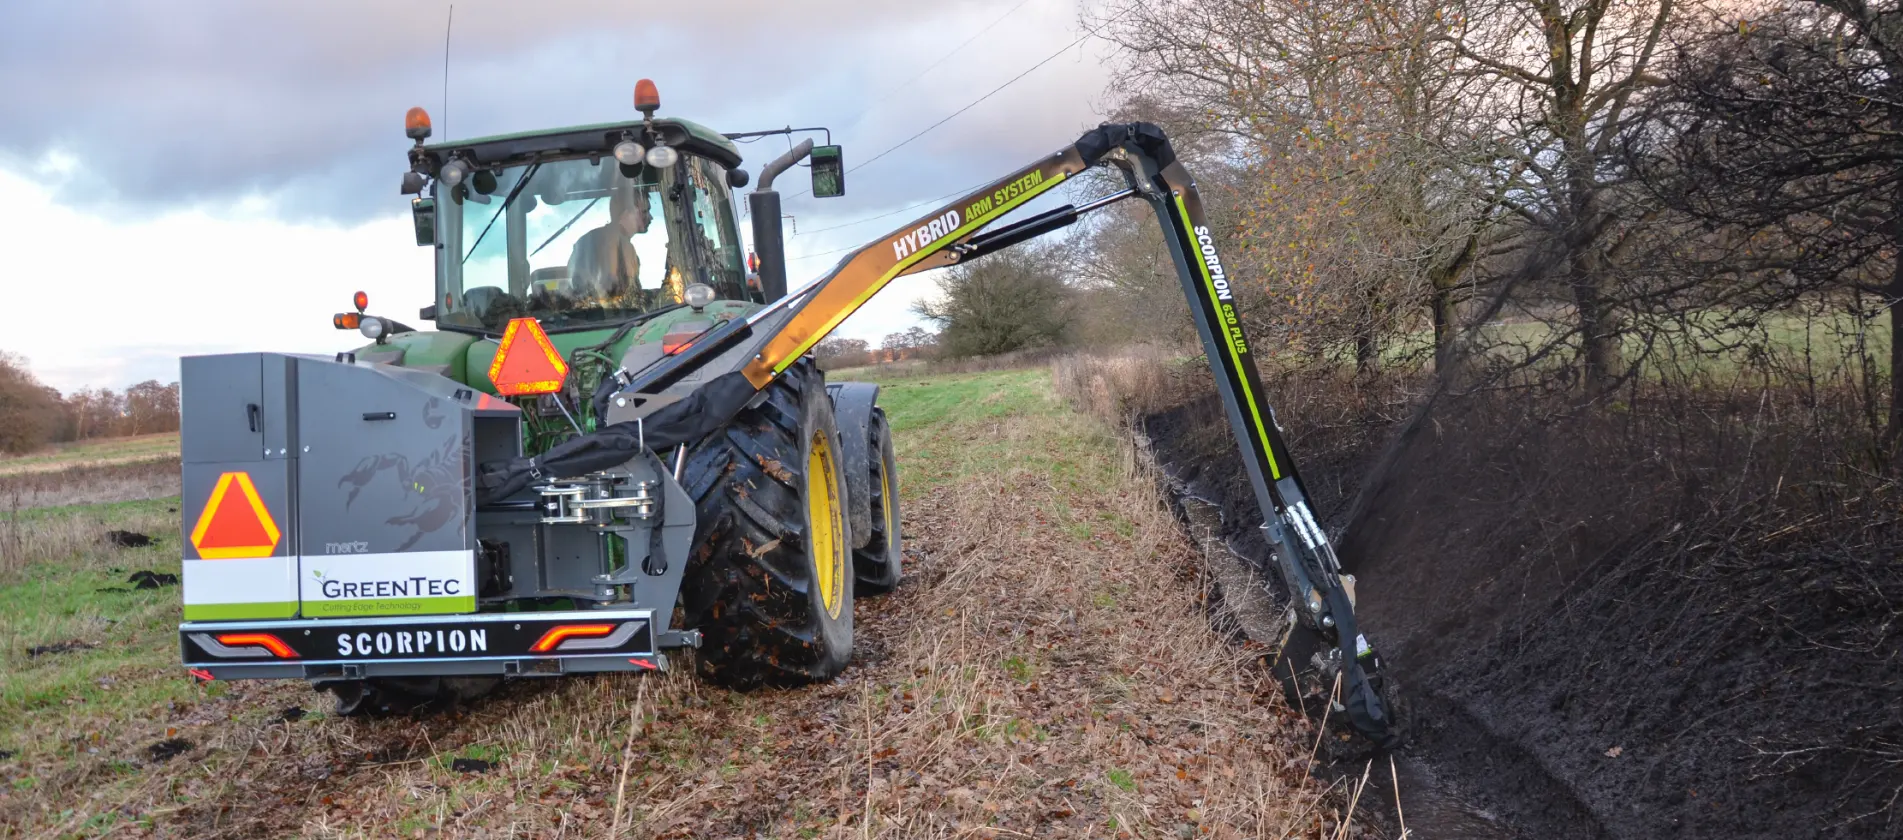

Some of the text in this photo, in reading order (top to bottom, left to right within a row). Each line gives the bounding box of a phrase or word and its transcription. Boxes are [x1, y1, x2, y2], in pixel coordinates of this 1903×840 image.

[893, 169, 1043, 260] HYBRID ARM SYSTEM
[1194, 225, 1248, 354] SCORPION 630 PLUS
[322, 600, 421, 612] Cutting Edge Technology
[337, 629, 487, 655] SCORPION
